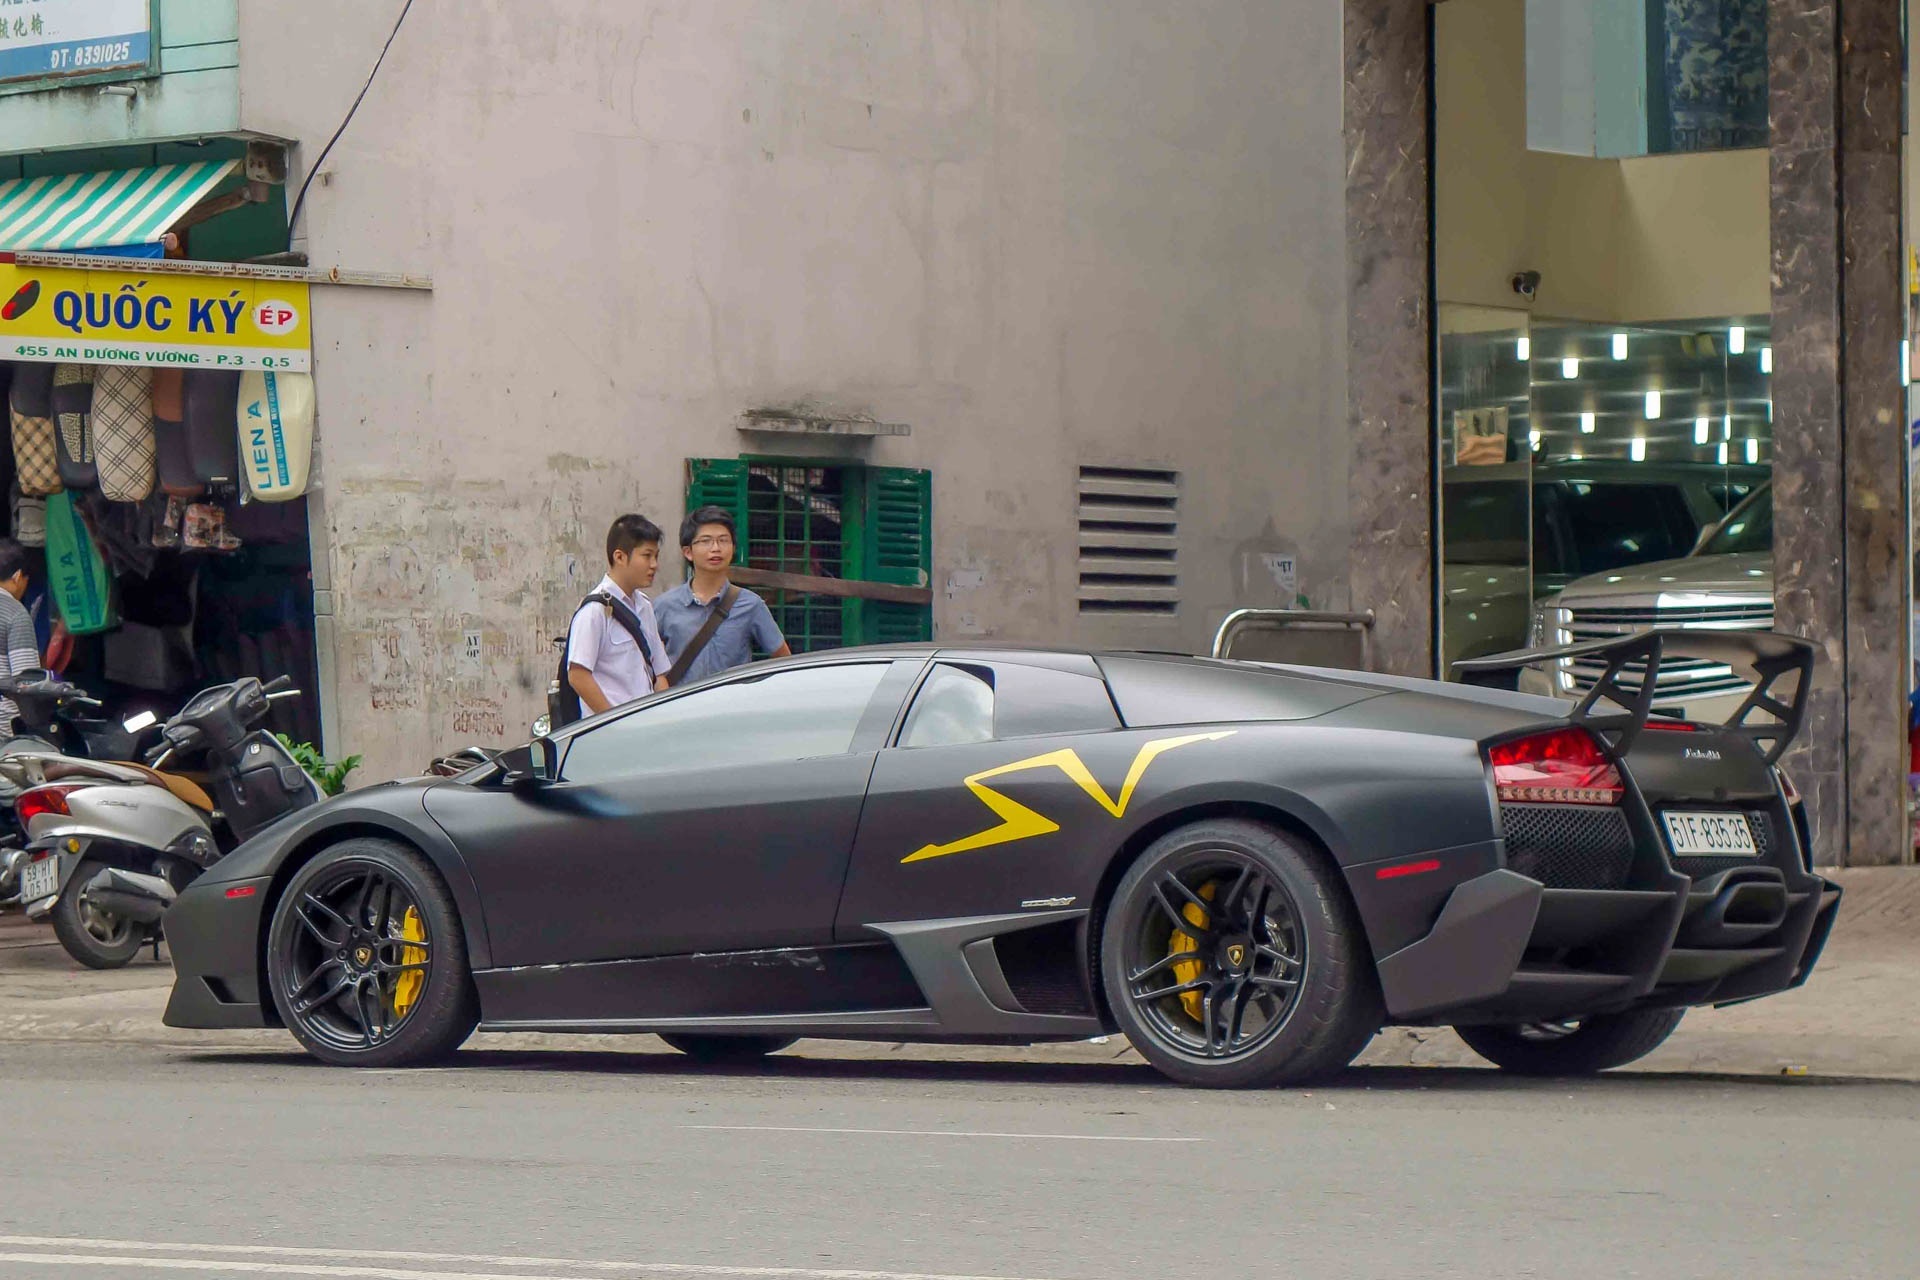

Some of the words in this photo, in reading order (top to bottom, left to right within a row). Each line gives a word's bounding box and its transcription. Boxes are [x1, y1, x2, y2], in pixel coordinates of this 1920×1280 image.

[74, 41, 131, 66] 8391025
[53, 280, 172, 334] QUỐC
[188, 290, 247, 334] KÝ
[259, 306, 293, 326] ÉP
[15, 345, 48, 357] 455
[54, 347, 78, 359] AN
[84, 346, 140, 361] DƯƠNG
[145, 350, 200, 364] VƯƠNG
[217, 355, 244, 366] P.3
[262, 356, 290, 368] Q.5
[250, 428, 273, 489] LIEN
[63, 575, 85, 629] LIEN
